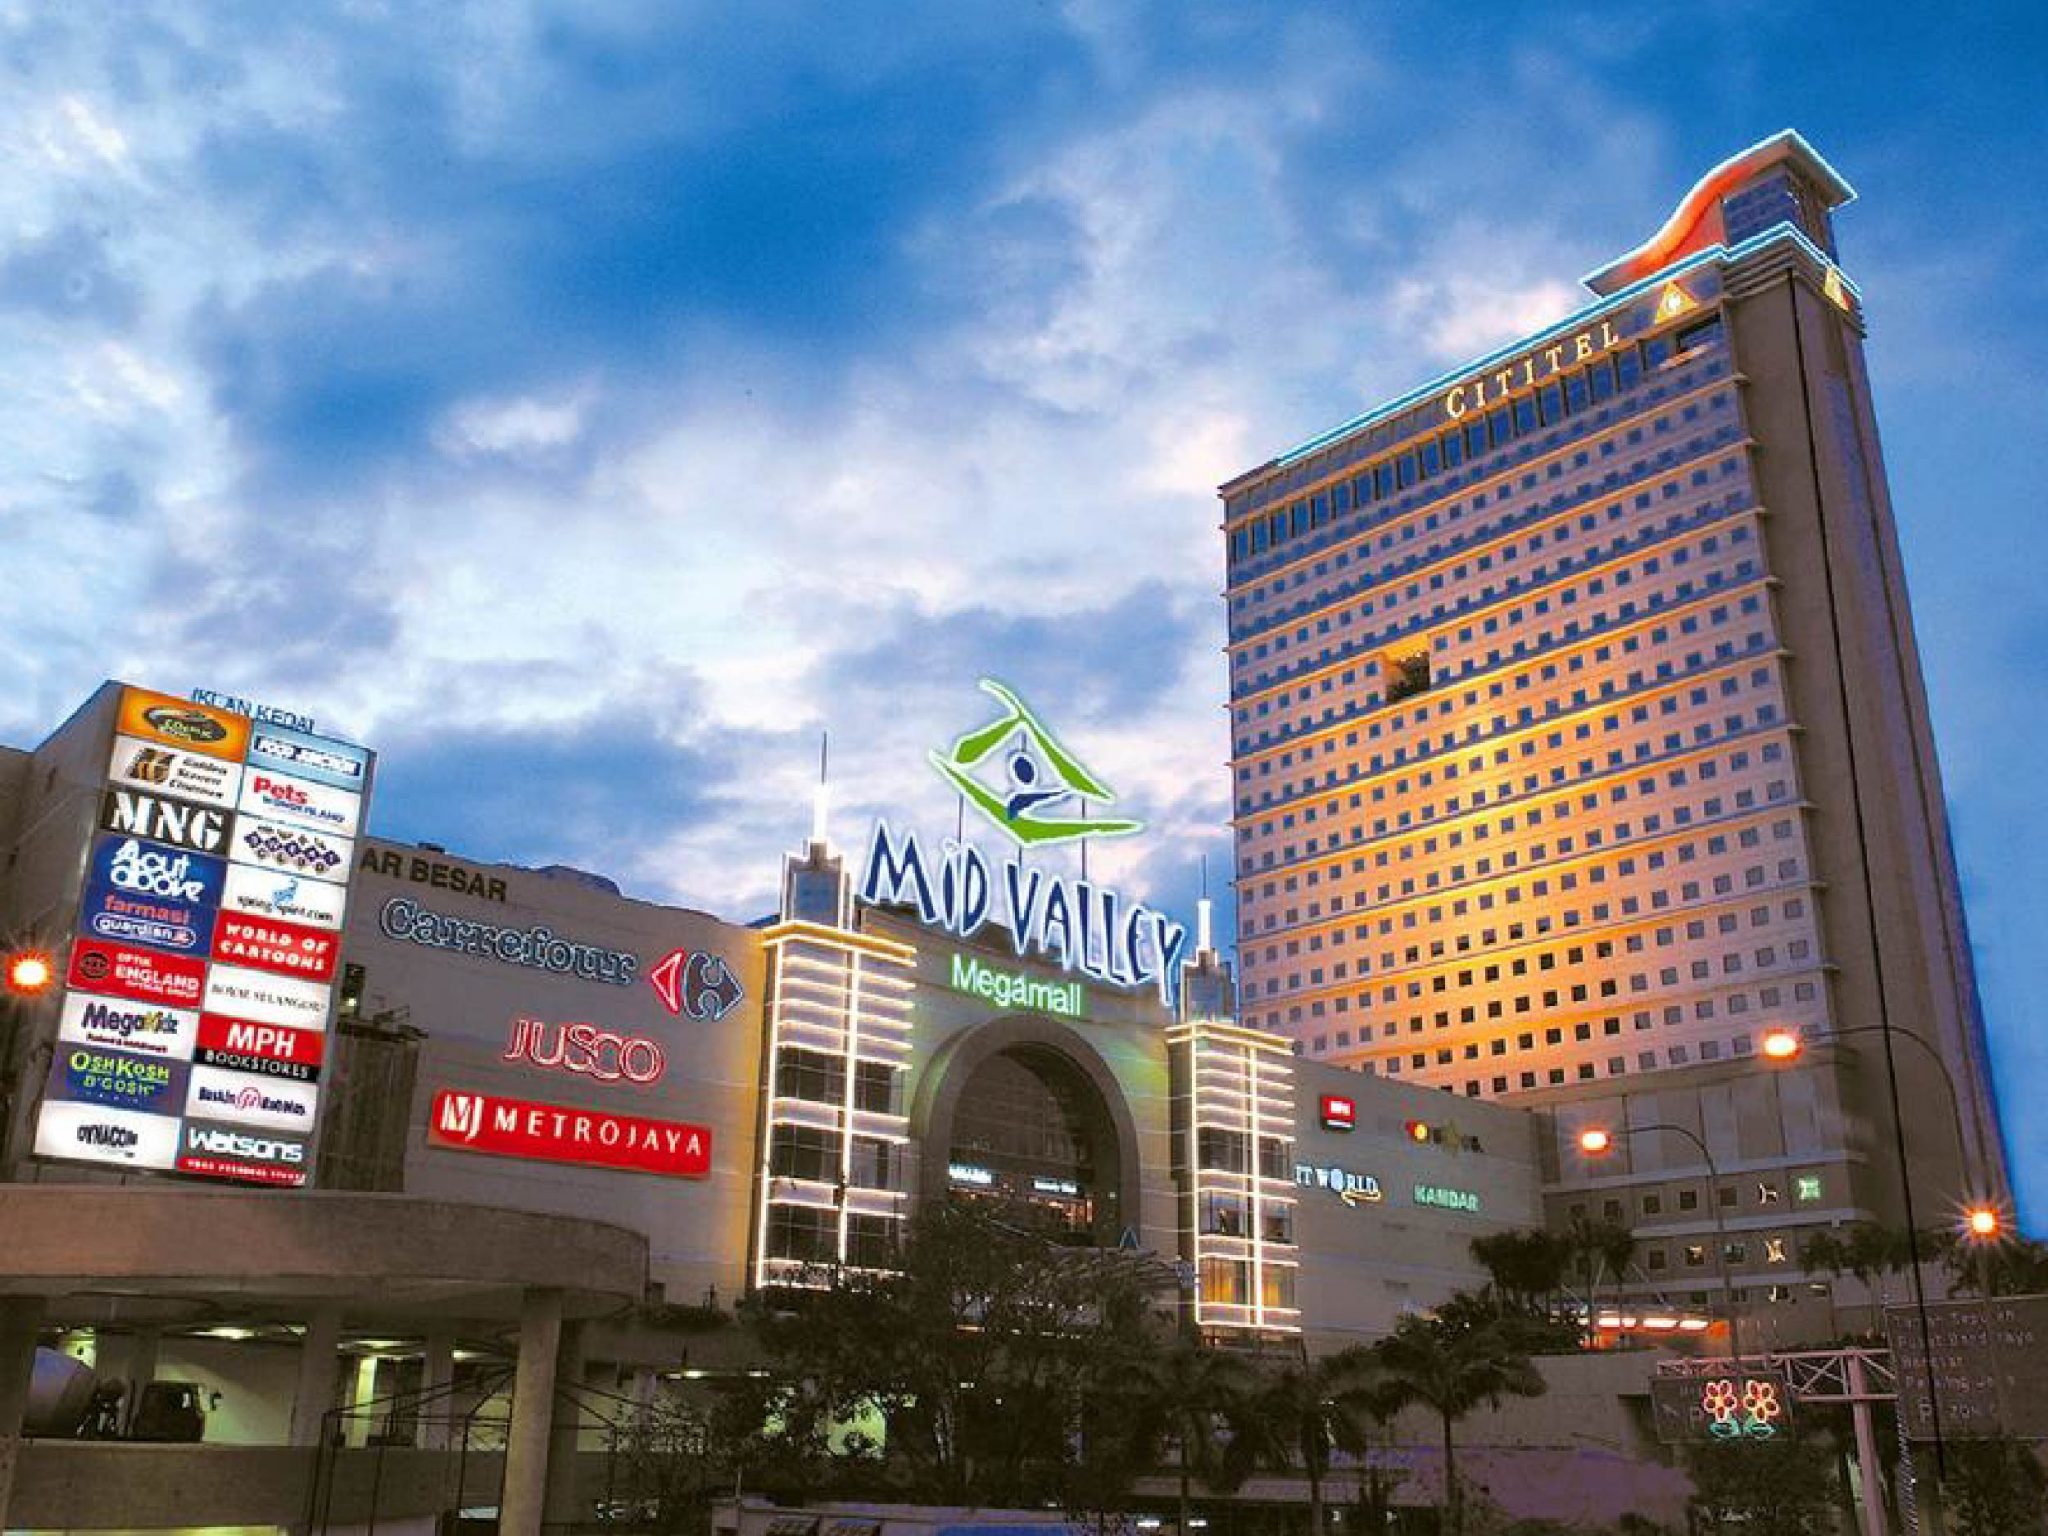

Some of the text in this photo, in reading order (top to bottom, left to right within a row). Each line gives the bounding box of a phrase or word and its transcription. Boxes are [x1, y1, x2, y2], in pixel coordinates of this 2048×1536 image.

[1447, 322, 1619, 418] CITITEL
[253, 776, 307, 804] Pets
[111, 791, 224, 850] MNG
[409, 858, 507, 901] BESAR
[219, 939, 325, 971] CARTOONS
[225, 922, 329, 954] WORLD OF
[379, 897, 637, 985] Carrefour
[1005, 861, 1184, 1008] VALLEY
[115, 964, 200, 989] ENGLAND
[951, 953, 1082, 1017] Megamall
[225, 1022, 297, 1058] MPH
[504, 1019, 665, 1083] JUSCO
[204, 1048, 310, 1079] BOOKSTORES
[495, 1107, 703, 1156] METROJAYA
